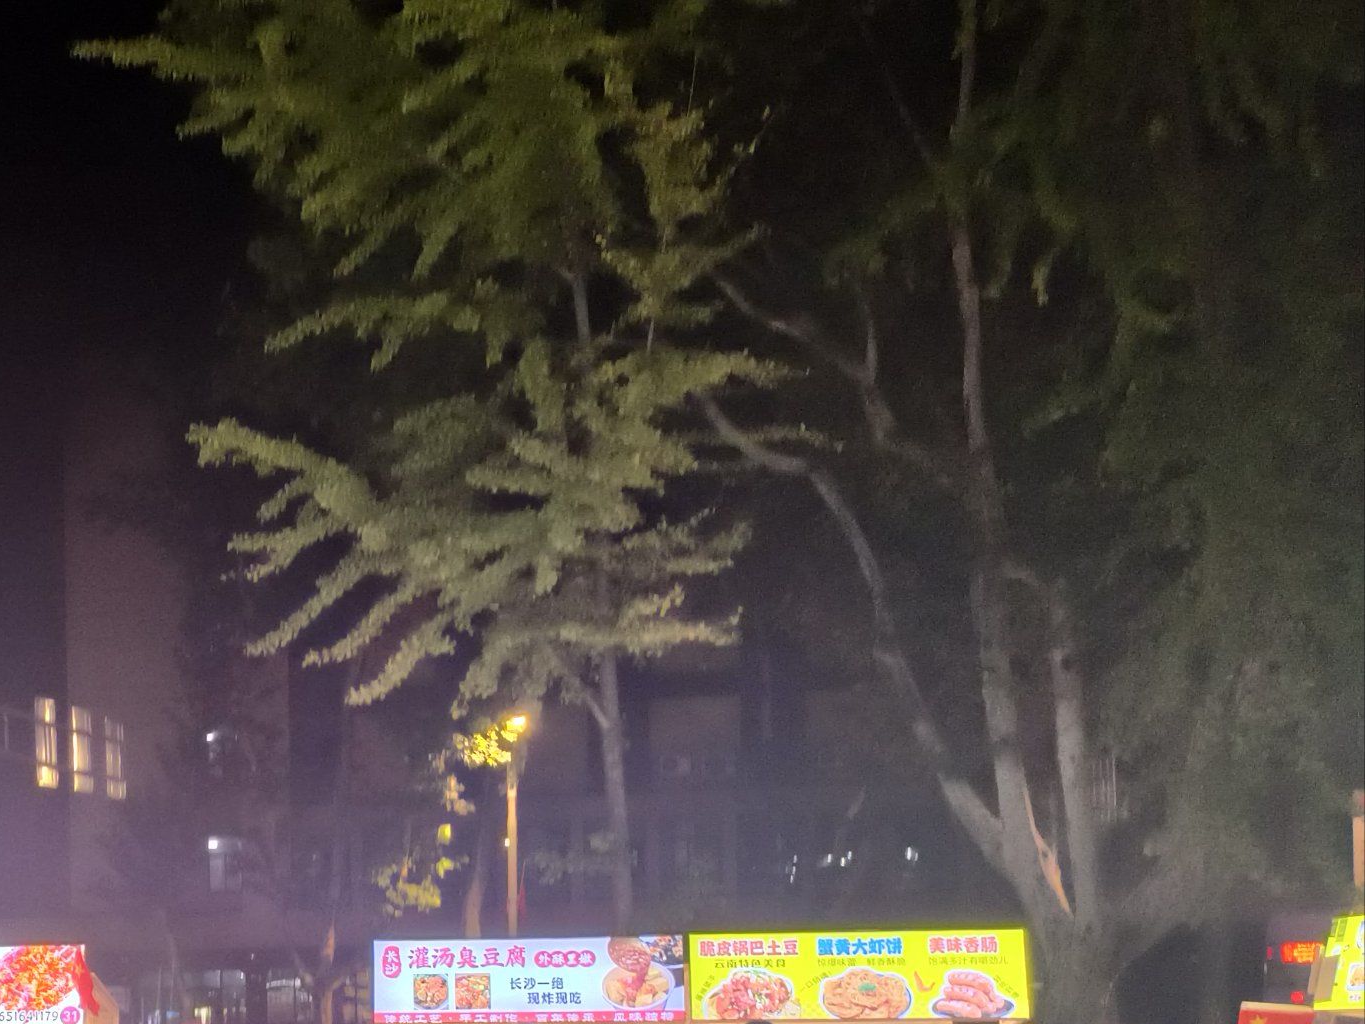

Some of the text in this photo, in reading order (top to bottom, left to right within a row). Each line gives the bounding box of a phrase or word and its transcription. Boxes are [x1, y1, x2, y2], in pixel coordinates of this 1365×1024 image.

[699, 939, 799, 956] 脆皮锅巴土豆
[818, 937, 902, 955] 蟹黄大虾饼
[929, 936, 997, 953] 美味香肠
[383, 949, 399, 974] 长沙
[408, 945, 526, 968] 灌汤臭豆腐
[509, 976, 564, 990] 长沙一绝
[527, 992, 582, 1005] 现炸现吃
[63, 1010, 77, 1022] 31
